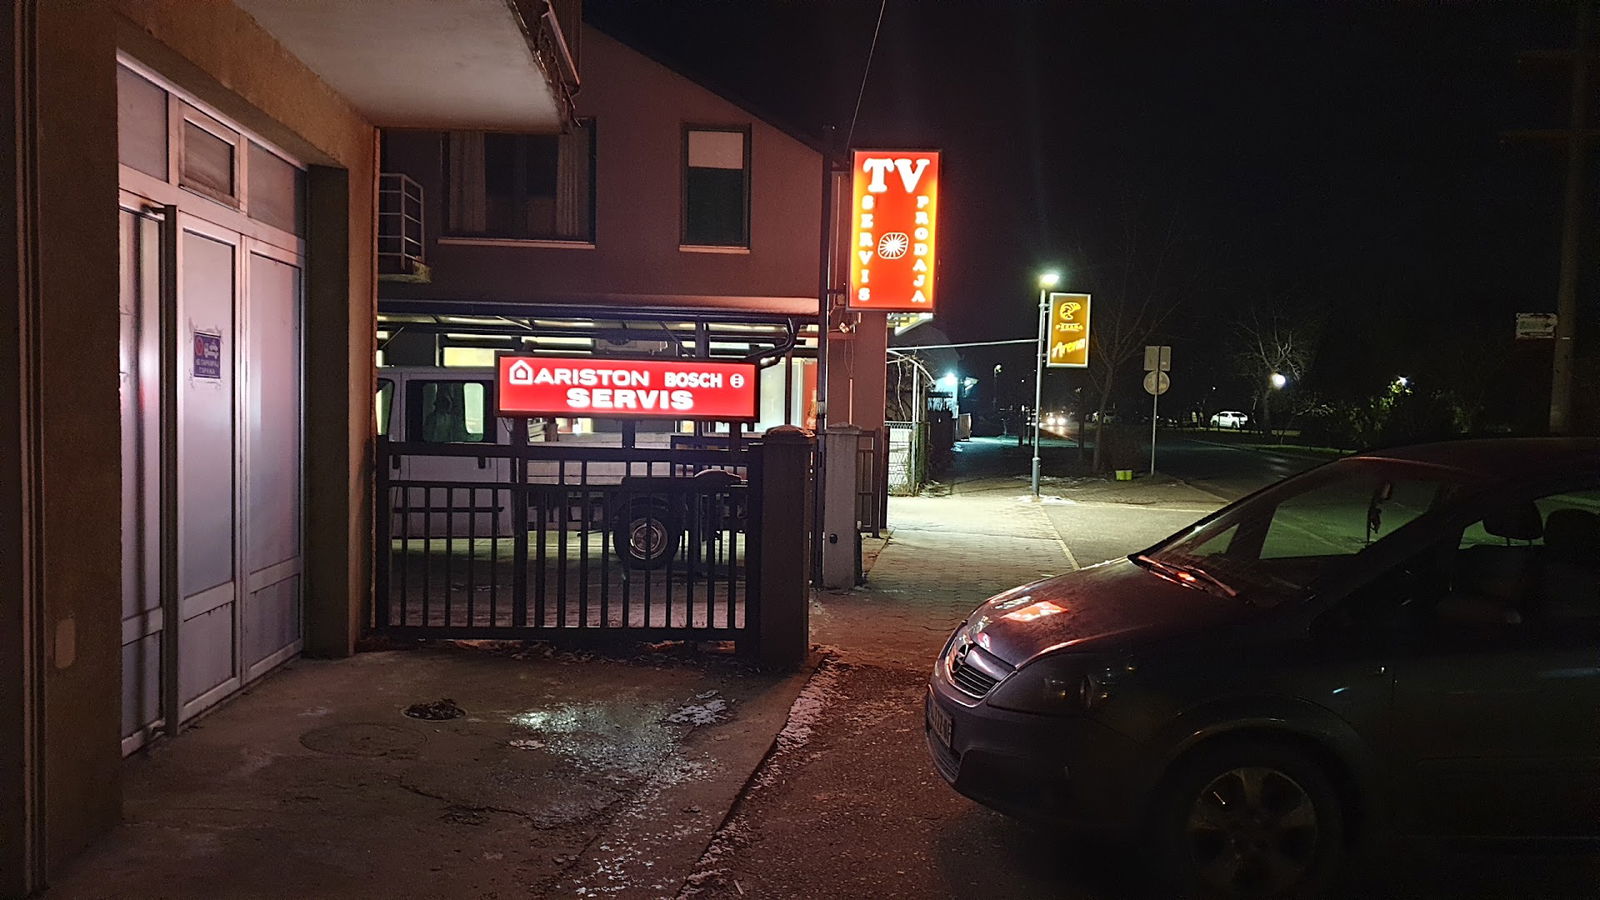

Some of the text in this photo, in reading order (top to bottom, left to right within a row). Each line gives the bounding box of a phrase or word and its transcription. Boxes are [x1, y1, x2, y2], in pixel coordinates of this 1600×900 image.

[863, 158, 930, 193] TV
[858, 196, 874, 301] SERVIS
[911, 196, 929, 302] PRODAJA
[534, 370, 722, 388] ARISTON BOSCH
[566, 388, 694, 410] SERVIS
